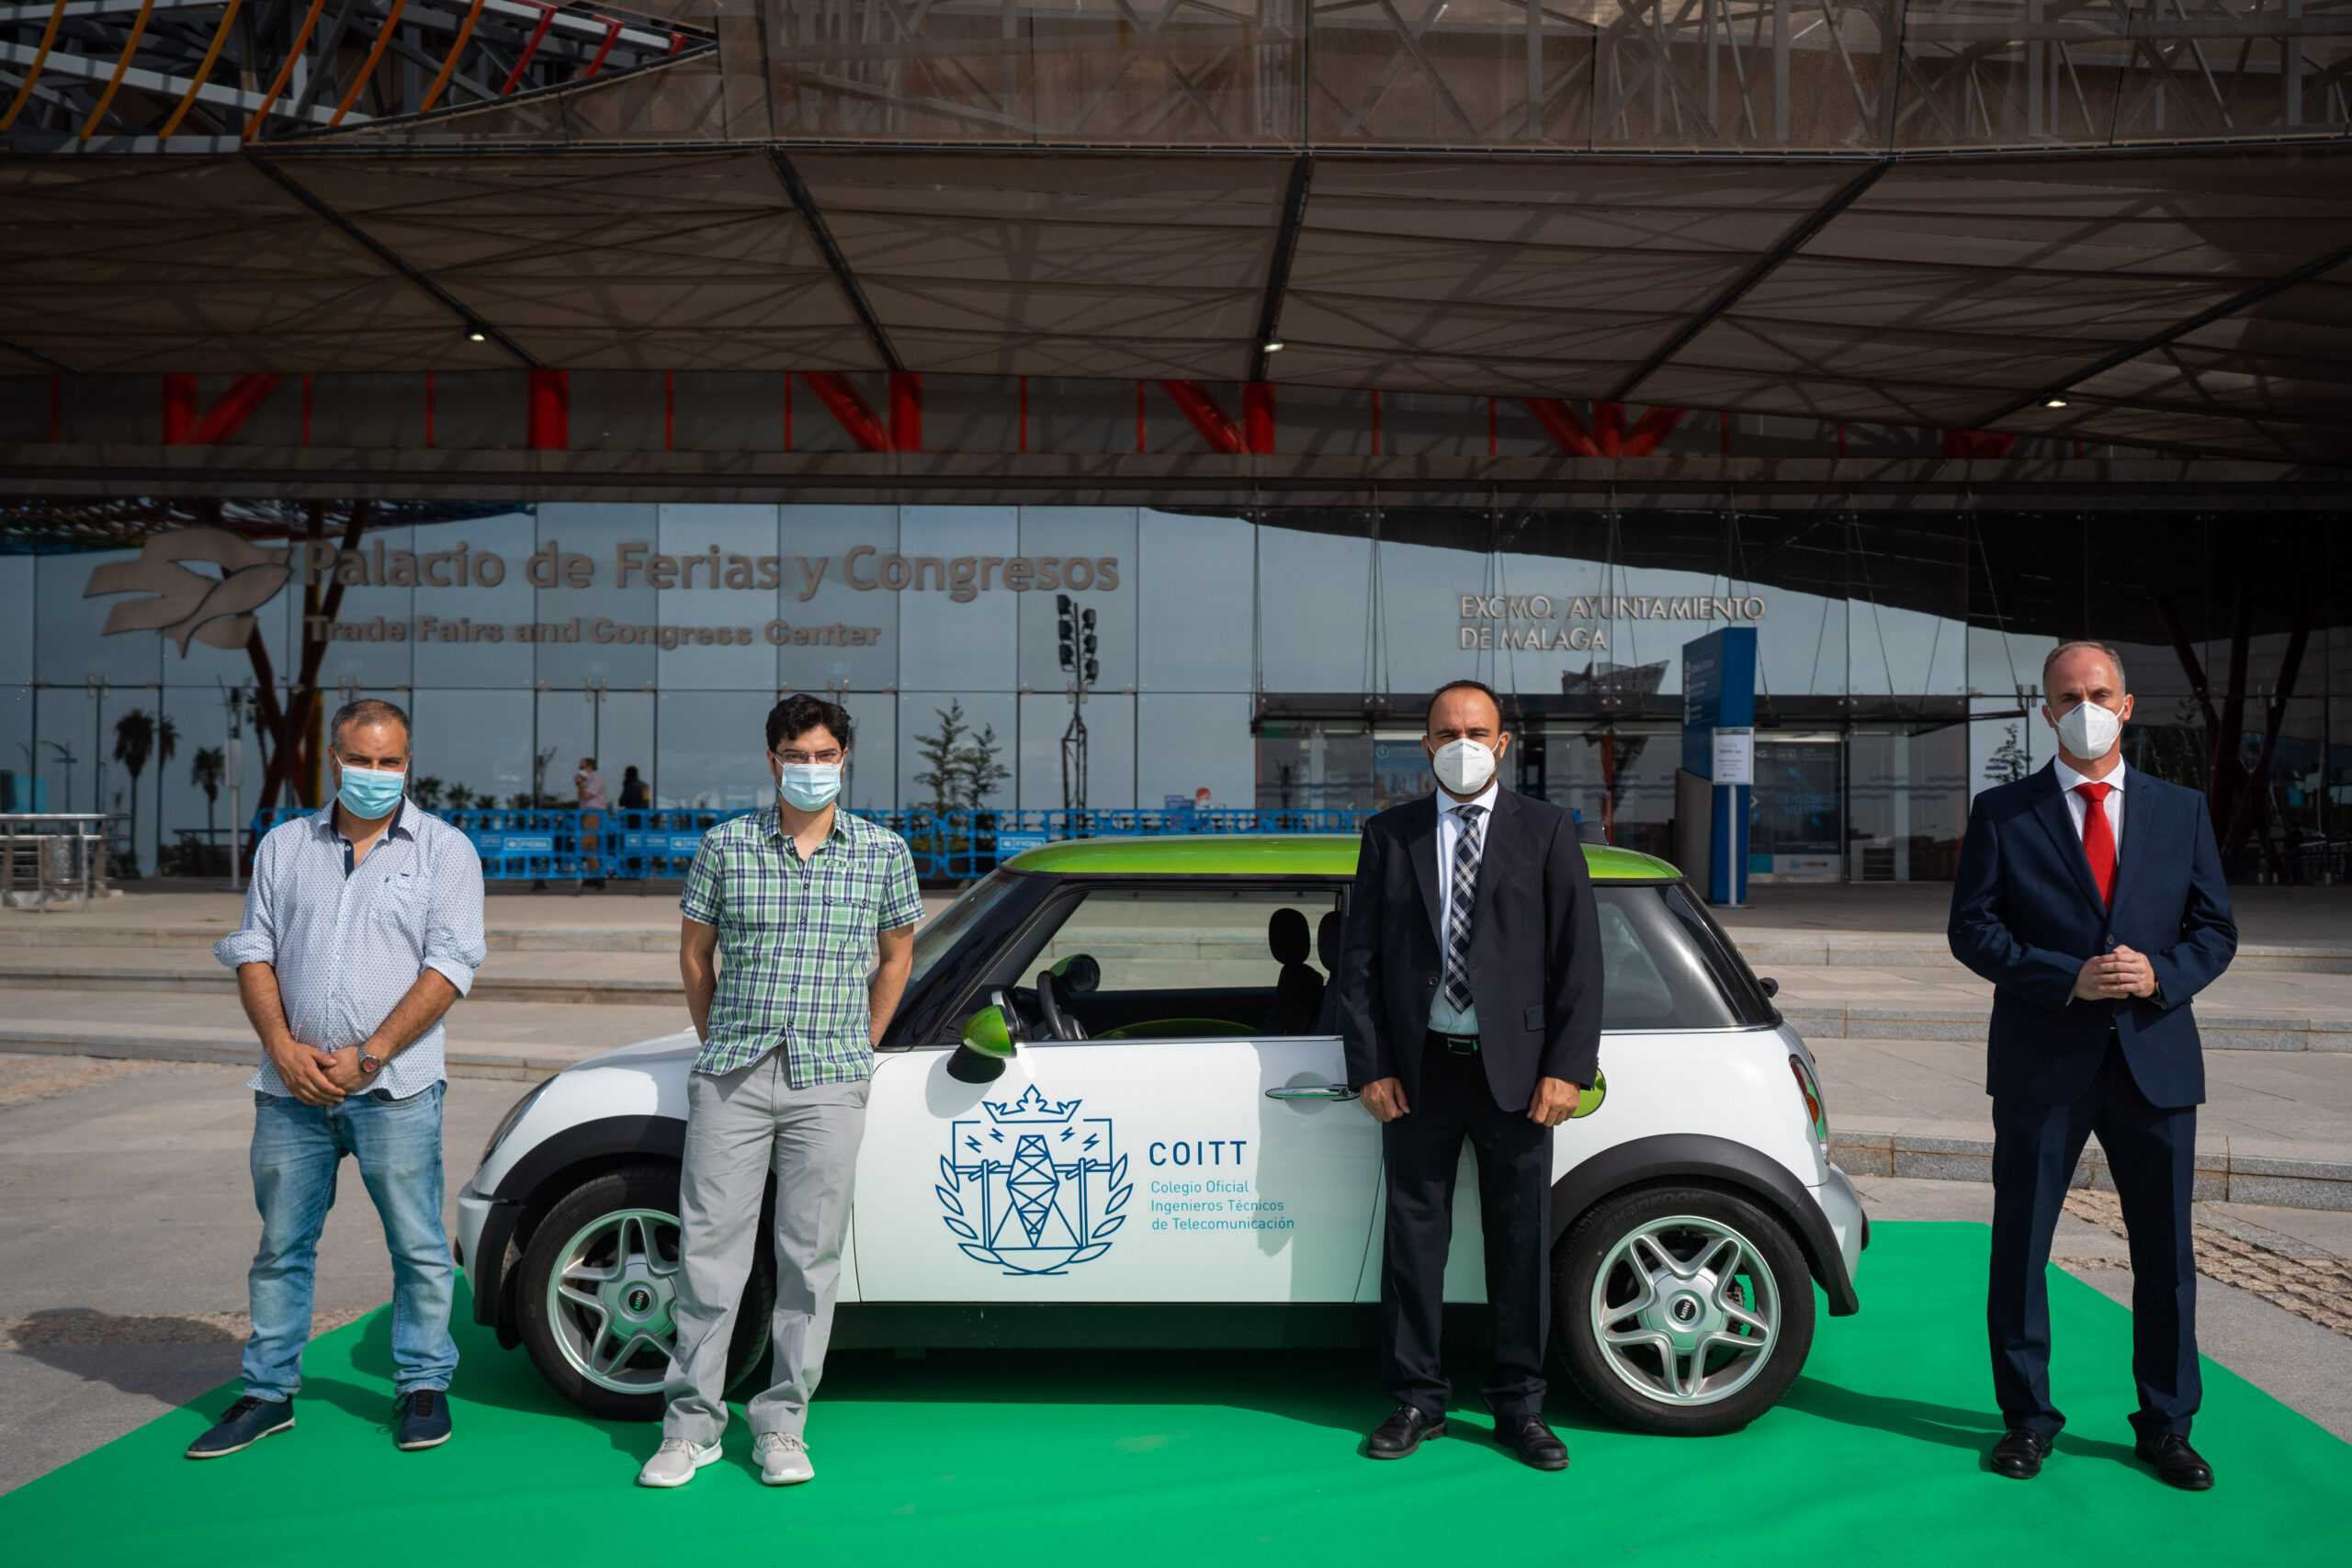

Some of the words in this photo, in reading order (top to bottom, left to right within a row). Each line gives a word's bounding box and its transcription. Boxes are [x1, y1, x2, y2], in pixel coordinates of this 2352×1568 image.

[304, 538, 506, 589] Palacio
[526, 540, 594, 589] de
[616, 544, 780, 591] Ferias
[797, 556, 829, 602] y
[843, 545, 1119, 604] Congresos
[1461, 595, 1556, 621] EXCMO.
[1567, 596, 1767, 621] AYUNTAMIENTO
[306, 615, 405, 643] Trade
[417, 617, 503, 643] Fairs
[515, 619, 581, 644] and
[588, 619, 752, 650] Congress
[764, 619, 883, 648] Center
[1461, 627, 1492, 650] DE
[1500, 621, 1607, 651] MÁLAGA
[1148, 1141, 1248, 1166] COITT
[1150, 1181, 1202, 1196] Colegio
[1206, 1180, 1250, 1193] Oficial
[1150, 1200, 1223, 1214] Ingenieros
[1227, 1198, 1284, 1212] Técnicos
[1151, 1218, 1168, 1230] de
[1172, 1215, 1295, 1230] Telecomunicación
[633, 1292, 645, 1310] MINI
[1679, 1302, 1691, 1319] MINI
